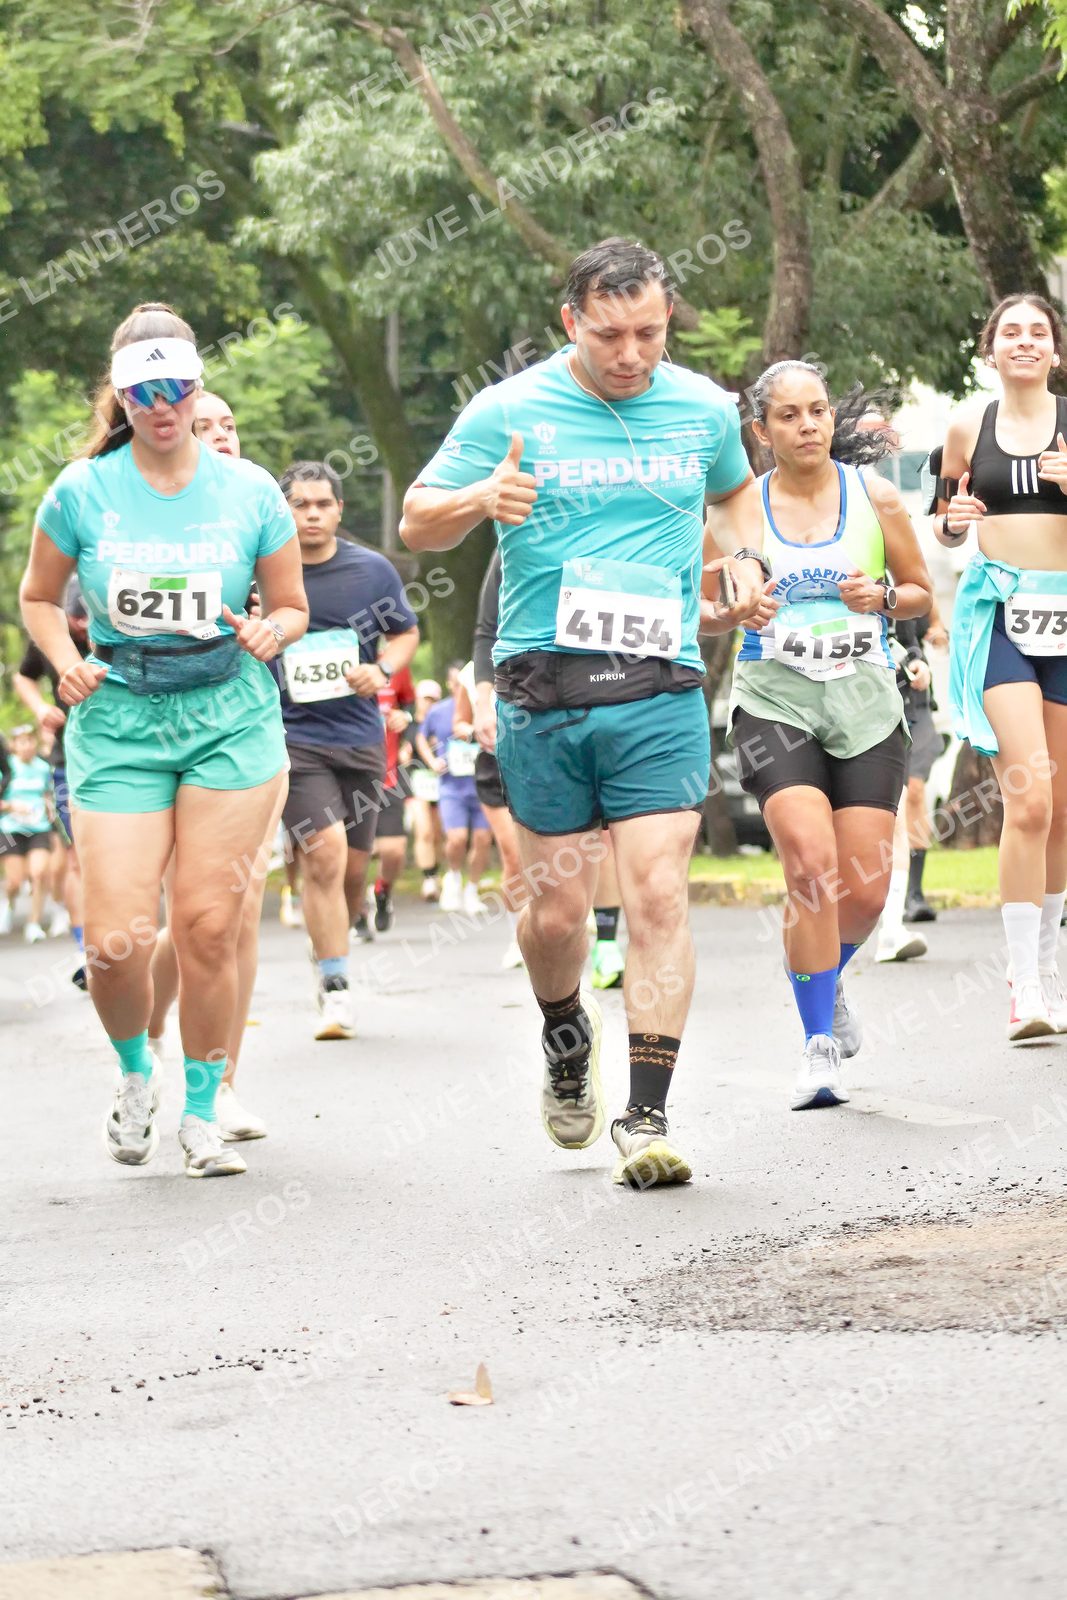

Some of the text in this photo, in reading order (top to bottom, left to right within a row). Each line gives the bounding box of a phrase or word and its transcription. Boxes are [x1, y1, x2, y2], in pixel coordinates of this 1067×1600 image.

[534, 454, 701, 487] PERDURA
[97, 539, 239, 563] PERDURA
[771, 572, 799, 596] PIES
[117, 589, 206, 620] 6211
[201, 630, 216, 639] 6211
[566, 609, 672, 651] 4154
[782, 632, 872, 659] 4155
[294, 660, 352, 684] 4380
[590, 672, 626, 683] KIPRUN
